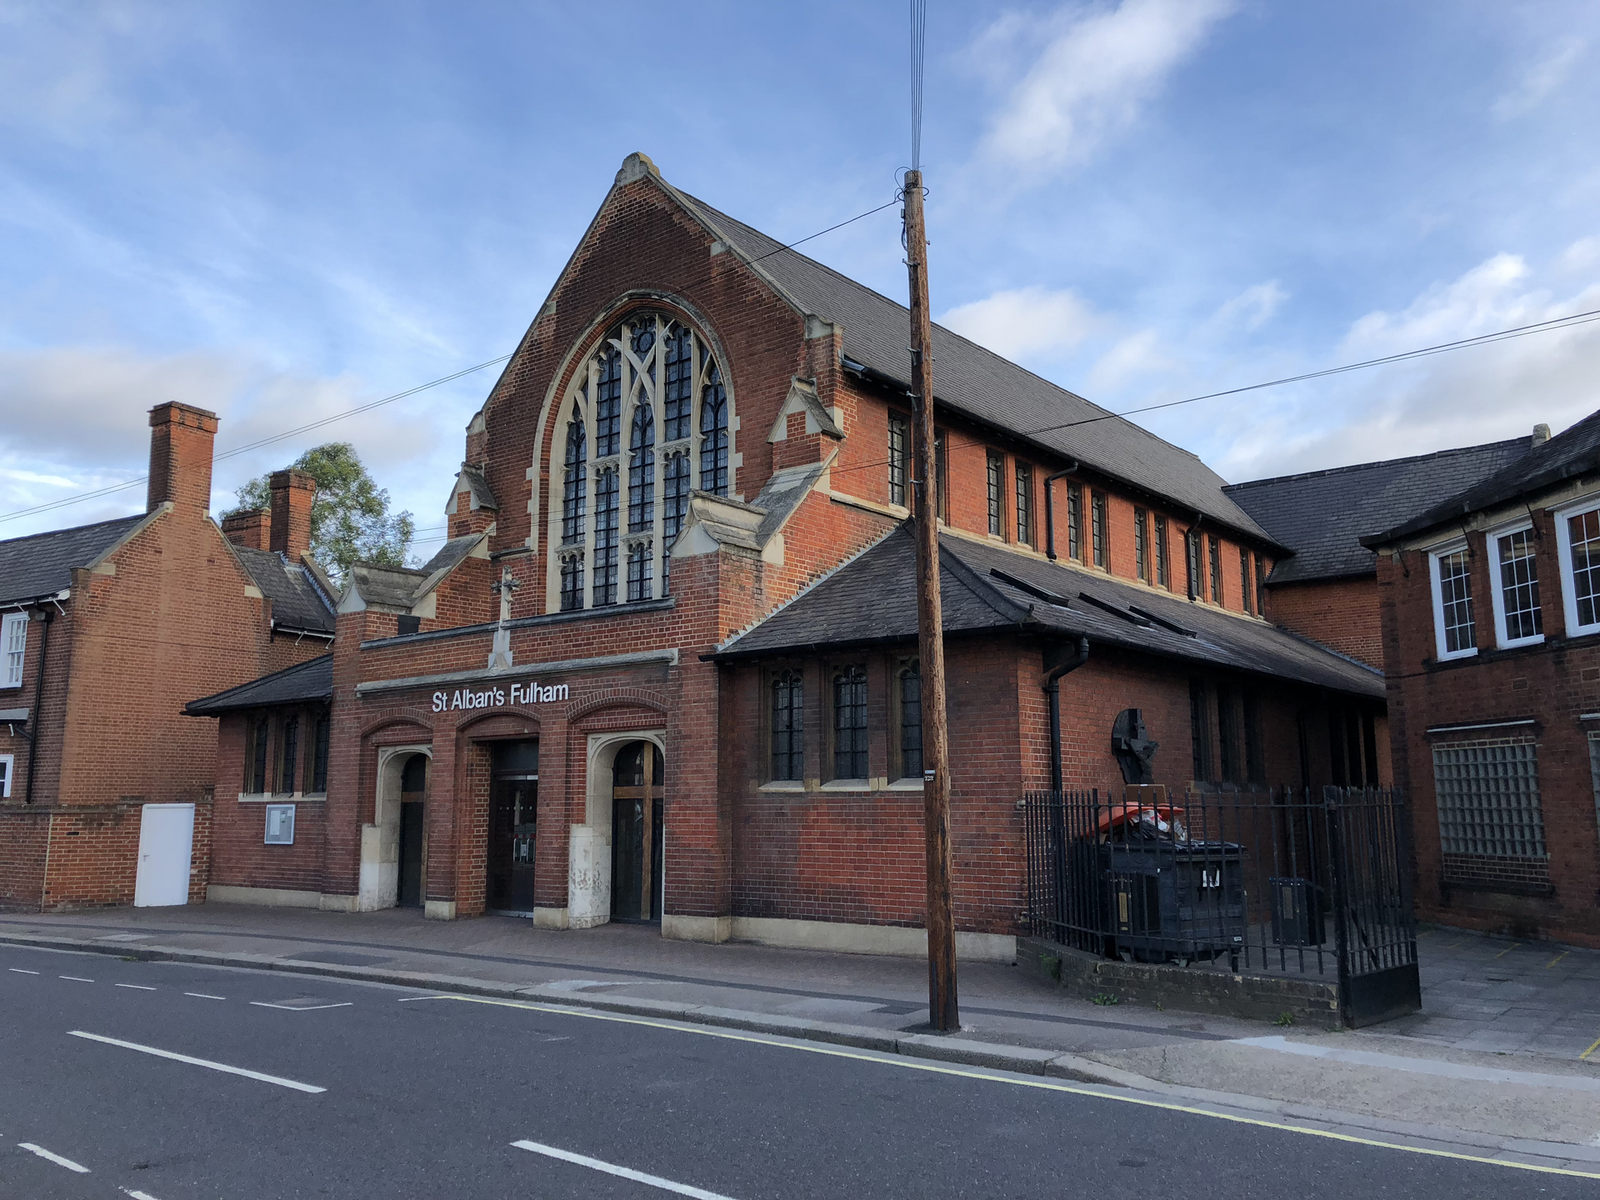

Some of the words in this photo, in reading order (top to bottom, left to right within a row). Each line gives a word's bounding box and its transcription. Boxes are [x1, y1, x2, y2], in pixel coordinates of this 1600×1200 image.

[432, 691, 448, 713] St
[450, 686, 505, 711] Alban's
[510, 682, 569, 705] Fulham
